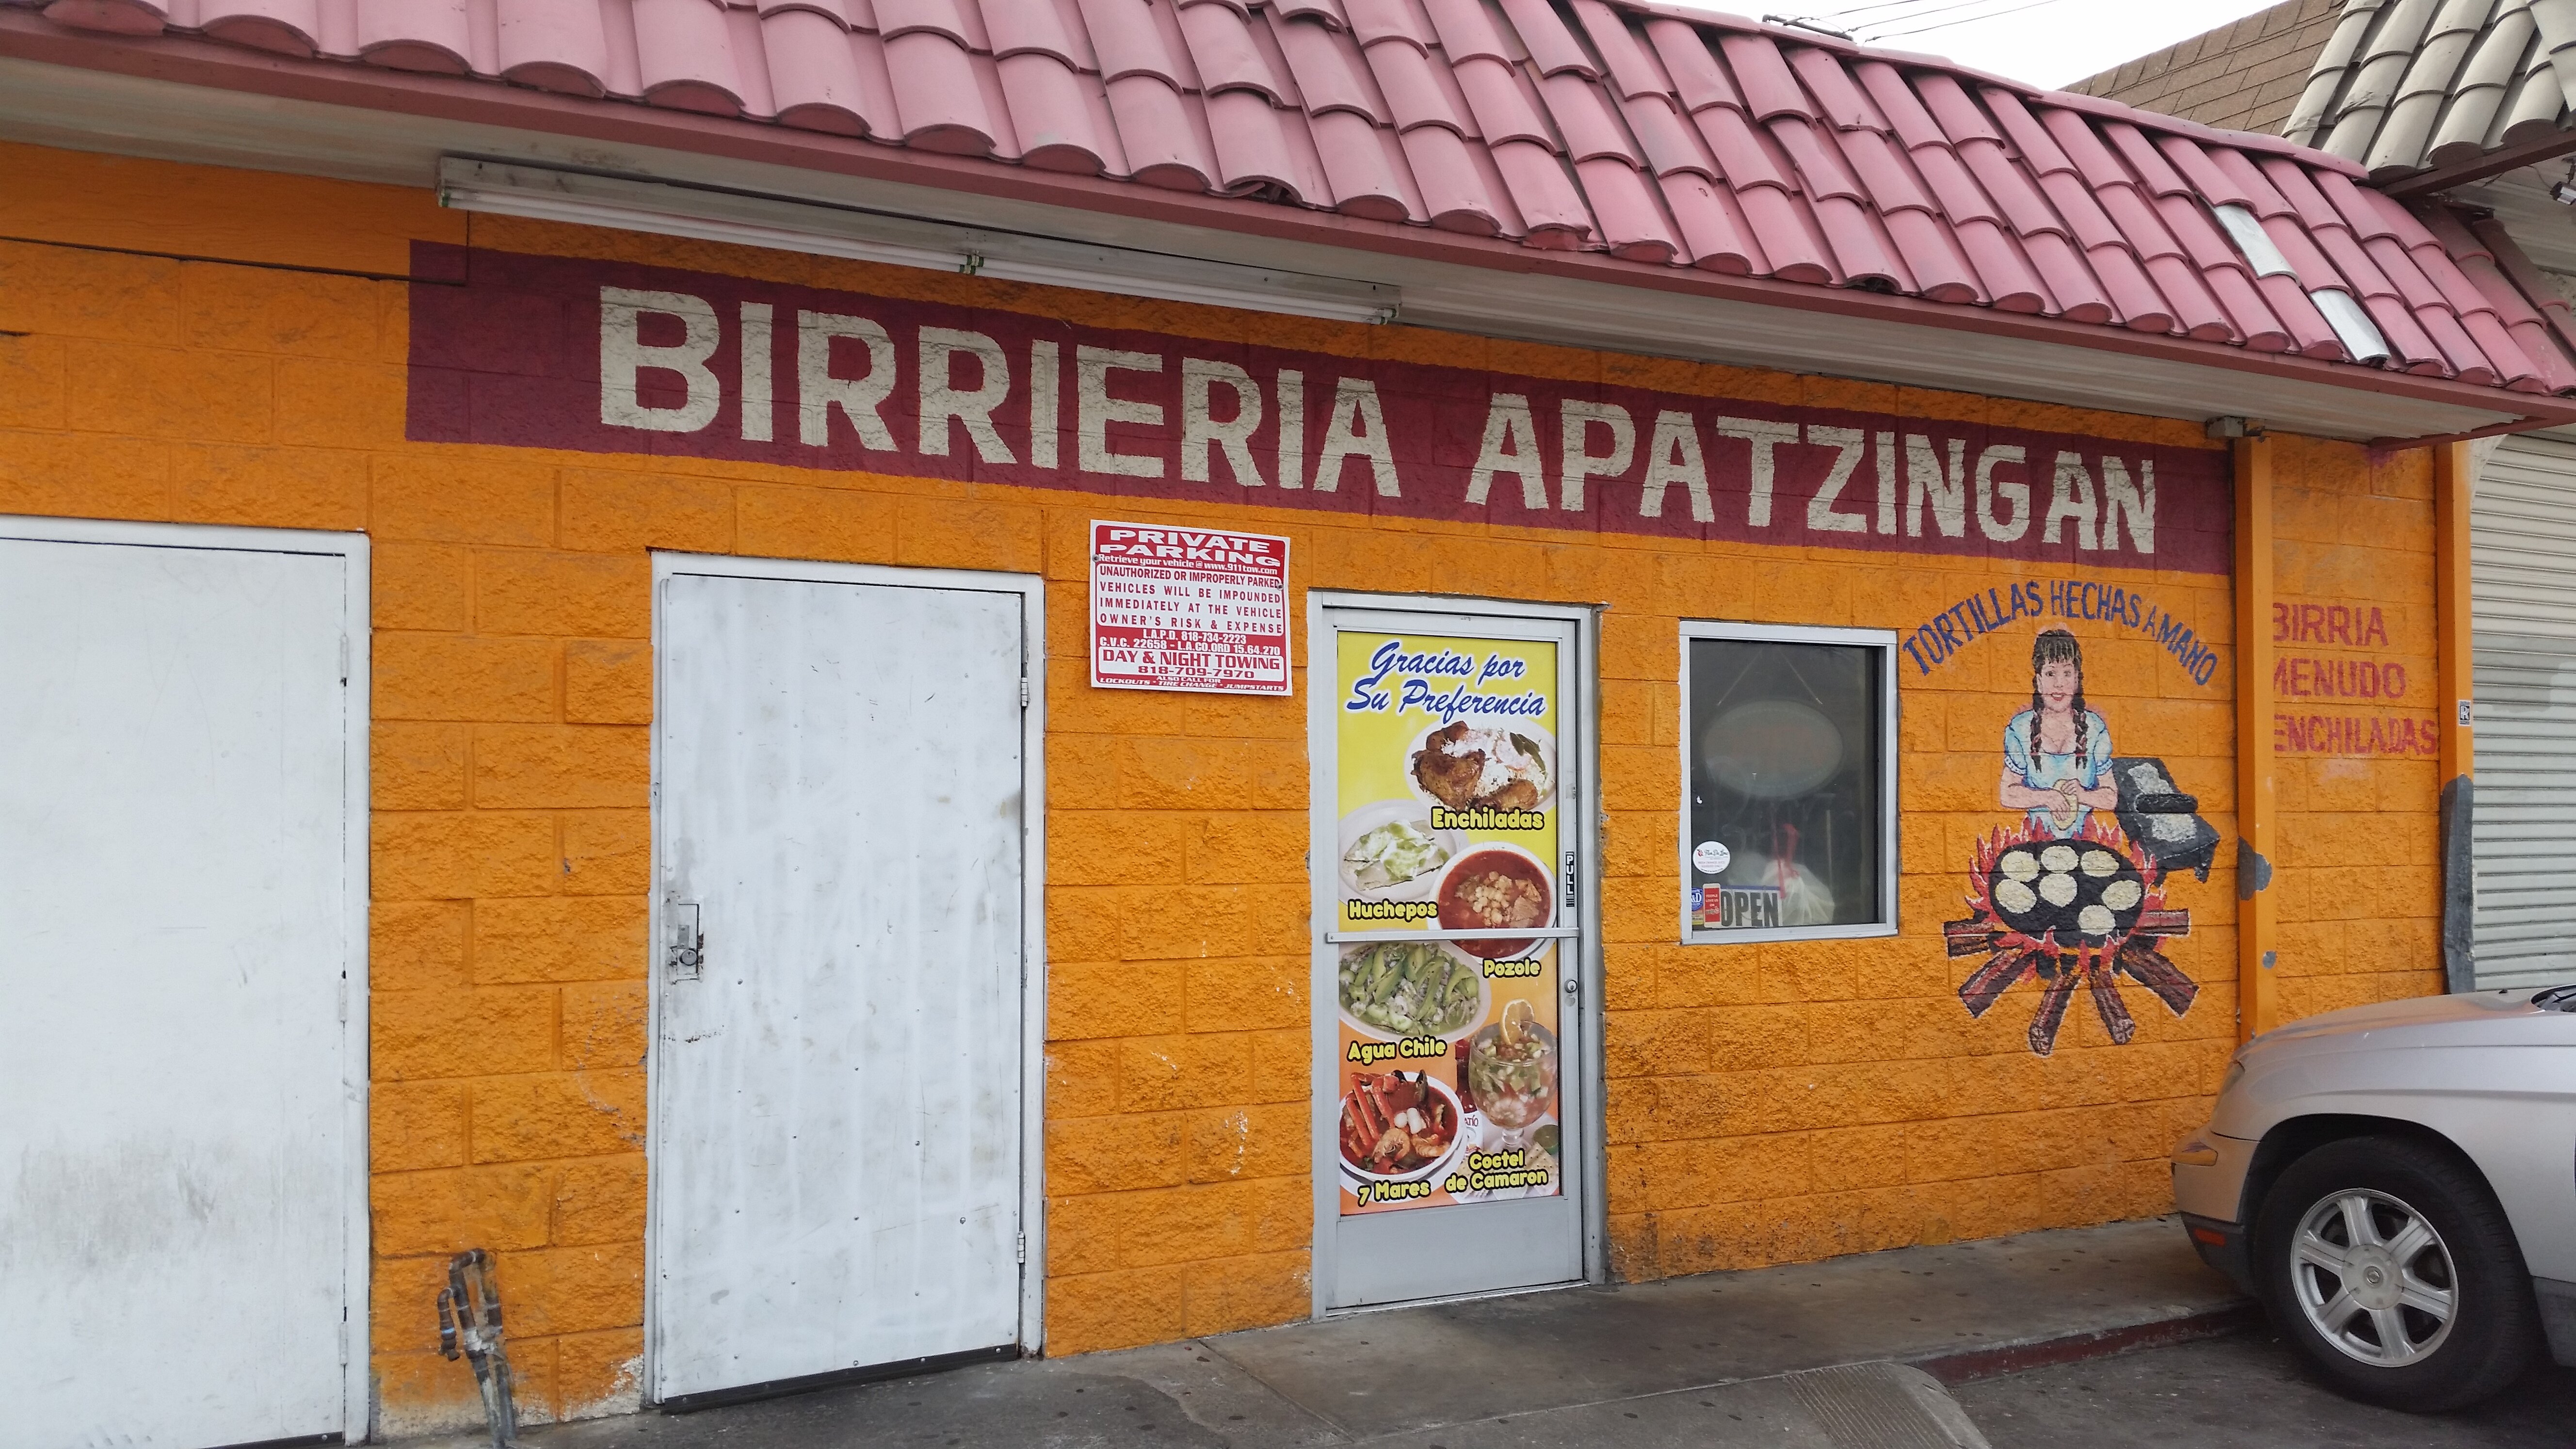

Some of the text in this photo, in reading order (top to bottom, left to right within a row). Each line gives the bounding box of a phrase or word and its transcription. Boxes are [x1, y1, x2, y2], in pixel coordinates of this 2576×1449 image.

[600, 285, 2157, 555] BIRRIERIA APATZINGAN
[1110, 530, 1270, 553] PRIVATE
[1098, 554, 1138, 564] Retrieve
[1140, 558, 1162, 566] your
[1162, 559, 1194, 568] vehicle
[1204, 563, 1277, 575] www.911tow.com
[1100, 544, 1281, 567] PARKING
[1100, 565, 1279, 588] UNAUTHORIZED OR IMPROPERLY PARKED
[1100, 581, 1280, 603] VEHICLES WILL BE IMPOUNDED
[1100, 597, 1281, 618] IMMEDIATELY AT THE VEHICLE
[1100, 613, 1282, 633] OWNER'S RISK & EXPENSE
[1902, 580, 2218, 686] TORTILLAS HECHAS A MANO
[2273, 602, 2389, 646] BIRRIA
[1099, 636, 1130, 647] C.V.C.
[1133, 638, 1167, 649] 22658
[1177, 641, 1230, 653] L.A.CO.ORD
[1233, 644, 1280, 655] 15.64.270
[1143, 628, 1246, 644] L.A.P.D. 818-734-2223
[1103, 649, 1280, 670] DAY & NIGHT TOWING
[1371, 641, 1525, 685] Gracias por
[1138, 666, 1255, 678] 818-709-7970
[1346, 677, 1546, 724] Su Preferencia
[2274, 714, 2438, 756] ENCHILADAS
[1431, 807, 1545, 829] Enchiladas
[1566, 855, 1574, 894] PULL
[1348, 900, 1438, 921] Huchepos
[1721, 891, 1779, 927] OPEN
[1483, 959, 1541, 977] Pozole
[1348, 1037, 1447, 1064] Agua Chile
[1465, 1114, 1479, 1127] ATÍO
[1469, 1149, 1524, 1170] Coctel
[1358, 1179, 1431, 1206] 7 Mares
[1445, 1170, 1548, 1193] de Camaron
